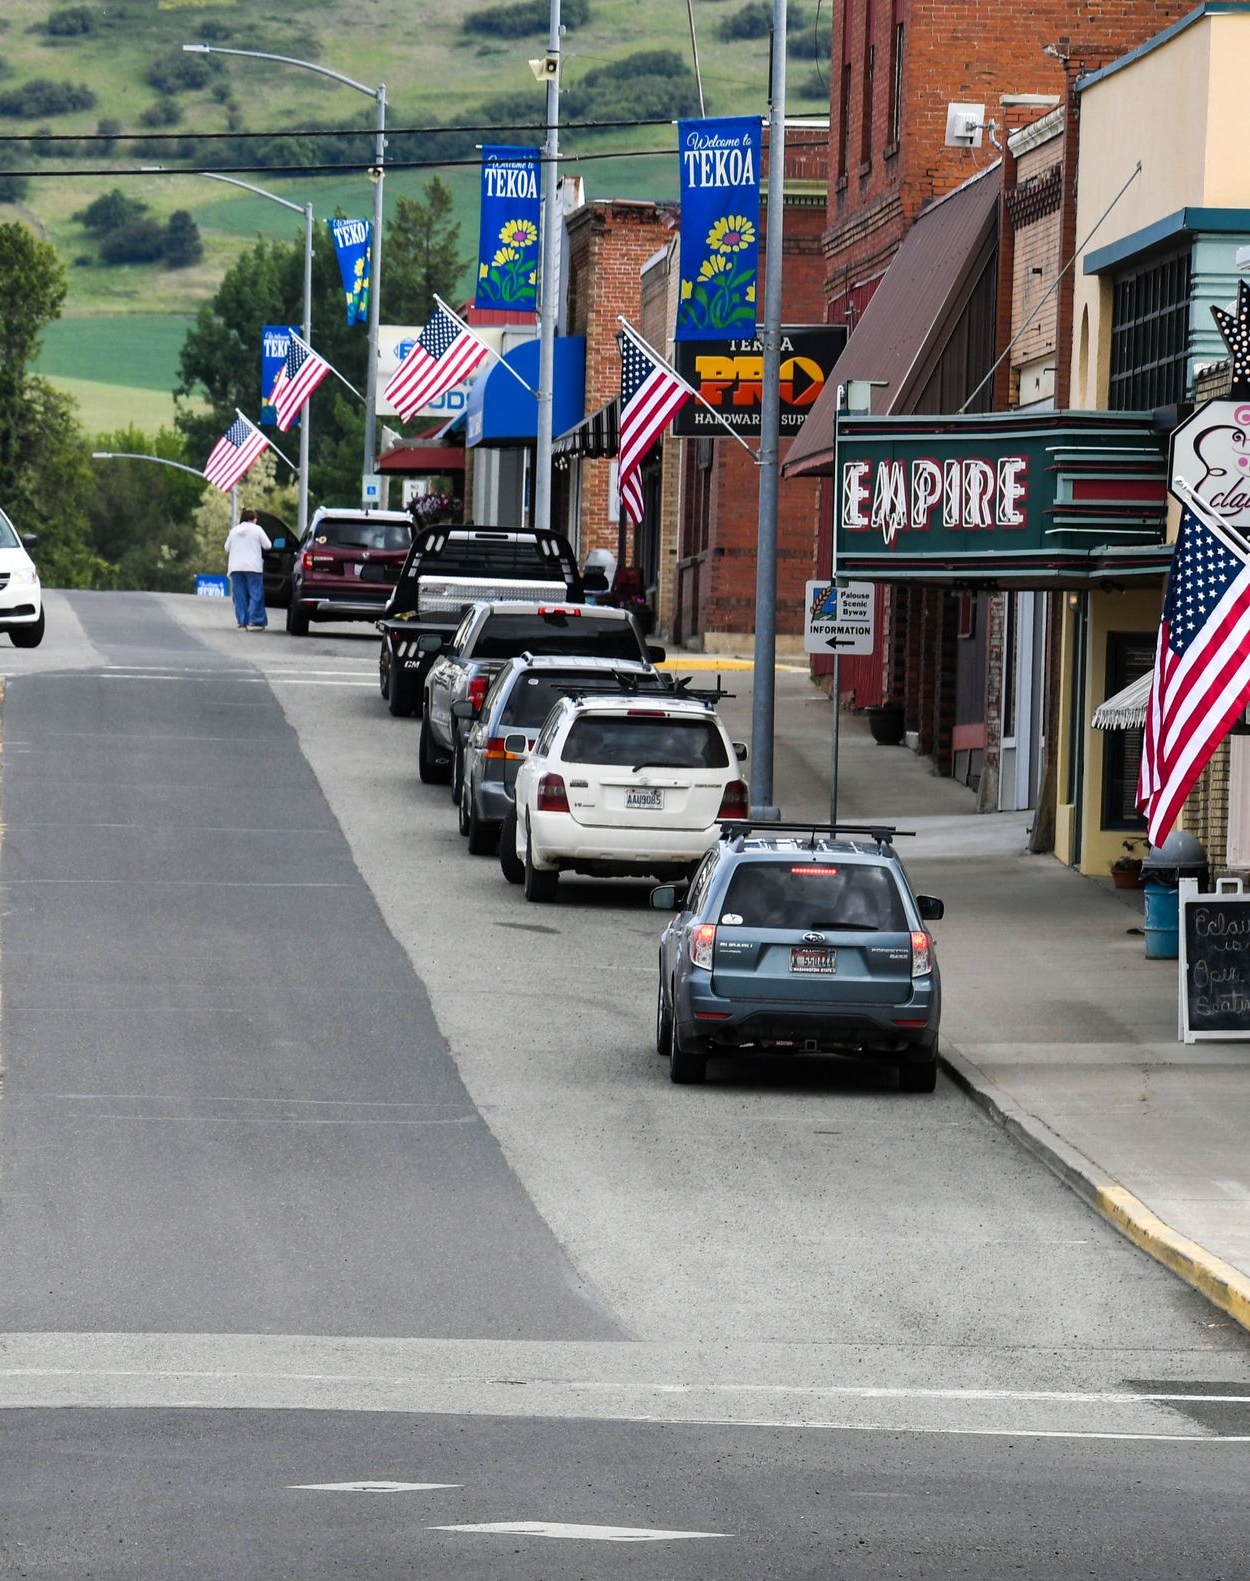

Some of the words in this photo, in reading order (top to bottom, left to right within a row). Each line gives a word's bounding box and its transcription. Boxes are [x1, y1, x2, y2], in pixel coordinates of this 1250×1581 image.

[687, 132, 740, 150] Welcome
[742, 133, 752, 146] to
[684, 148, 755, 188] TEKOA
[485, 168, 538, 198] TEKOA
[729, 337, 794, 351] TEKA
[695, 356, 825, 406] PRO
[694, 413, 762, 425] HARDWAR
[781, 414, 808, 425] SUP
[842, 456, 1028, 547] EMPIRE
[841, 591, 870, 599] Palouse
[843, 600, 867, 608] Scenic
[843, 609, 867, 617] Byway
[810, 626, 871, 635] INFORMATION
